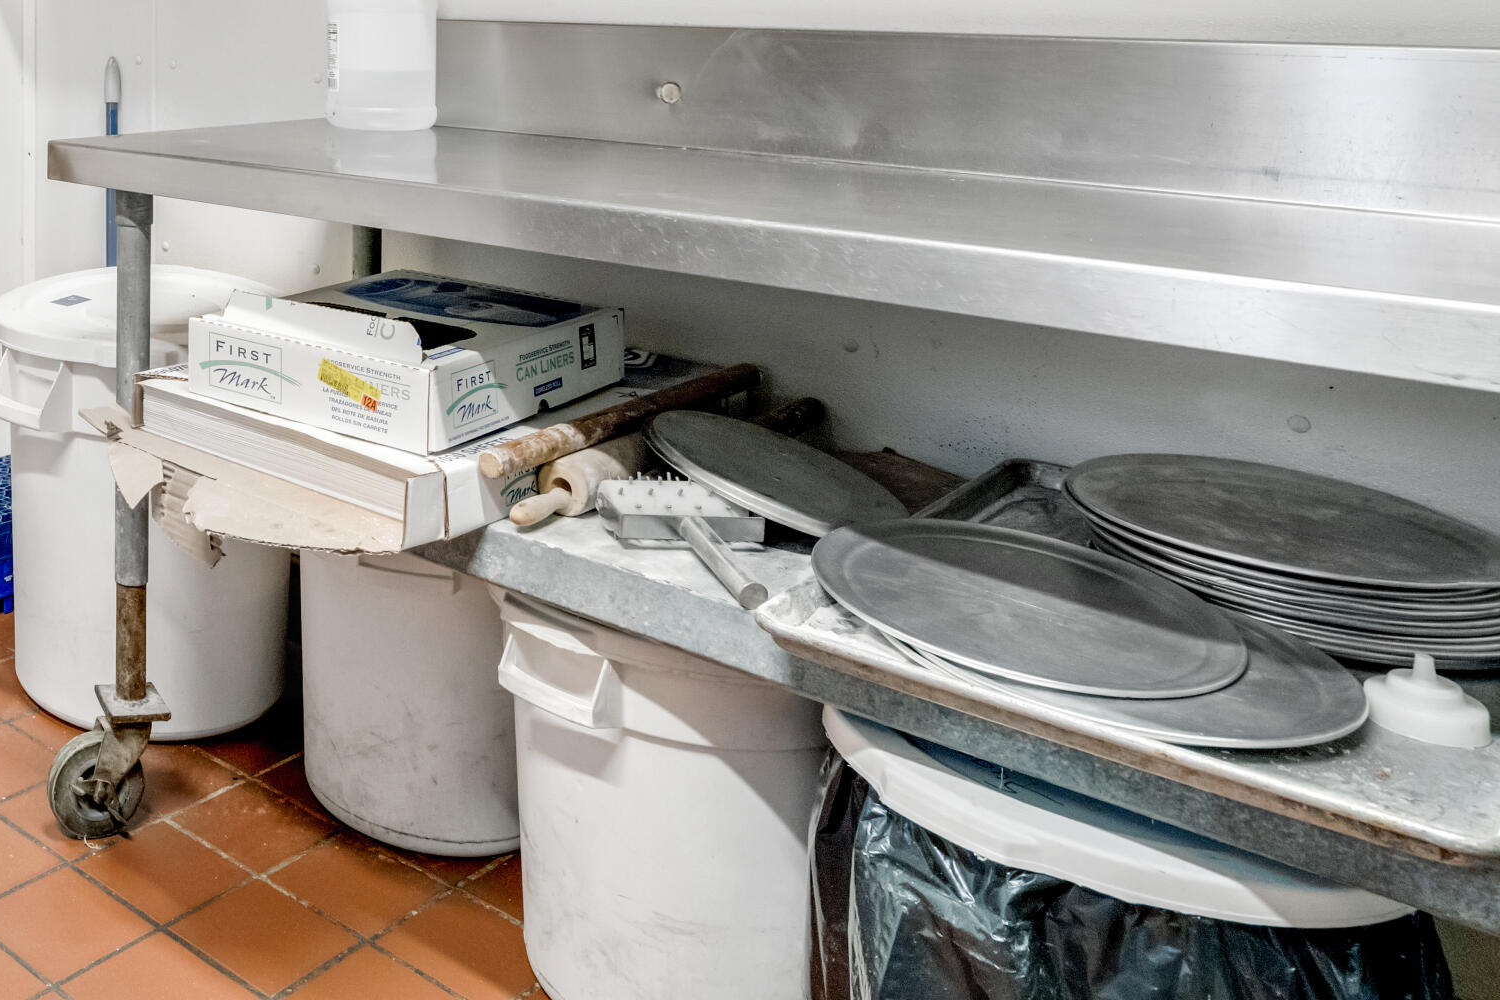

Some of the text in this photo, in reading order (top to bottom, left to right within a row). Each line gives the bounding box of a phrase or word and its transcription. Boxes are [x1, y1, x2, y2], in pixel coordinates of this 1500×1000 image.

[216, 340, 272, 363] FIRST
[520, 340, 571, 360] FOODSERVICE STRENGTH
[366, 367, 401, 380] STRENGTH
[516, 352, 575, 381] CAN LINERS
[213, 368, 271, 395] Mark
[456, 370, 491, 392] FIRST
[362, 394, 377, 410] 12A
[378, 400, 398, 410] ERVICE
[457, 394, 493, 422] Mark
[362, 421, 388, 434] CARRETE
[506, 480, 540, 503] Mark
